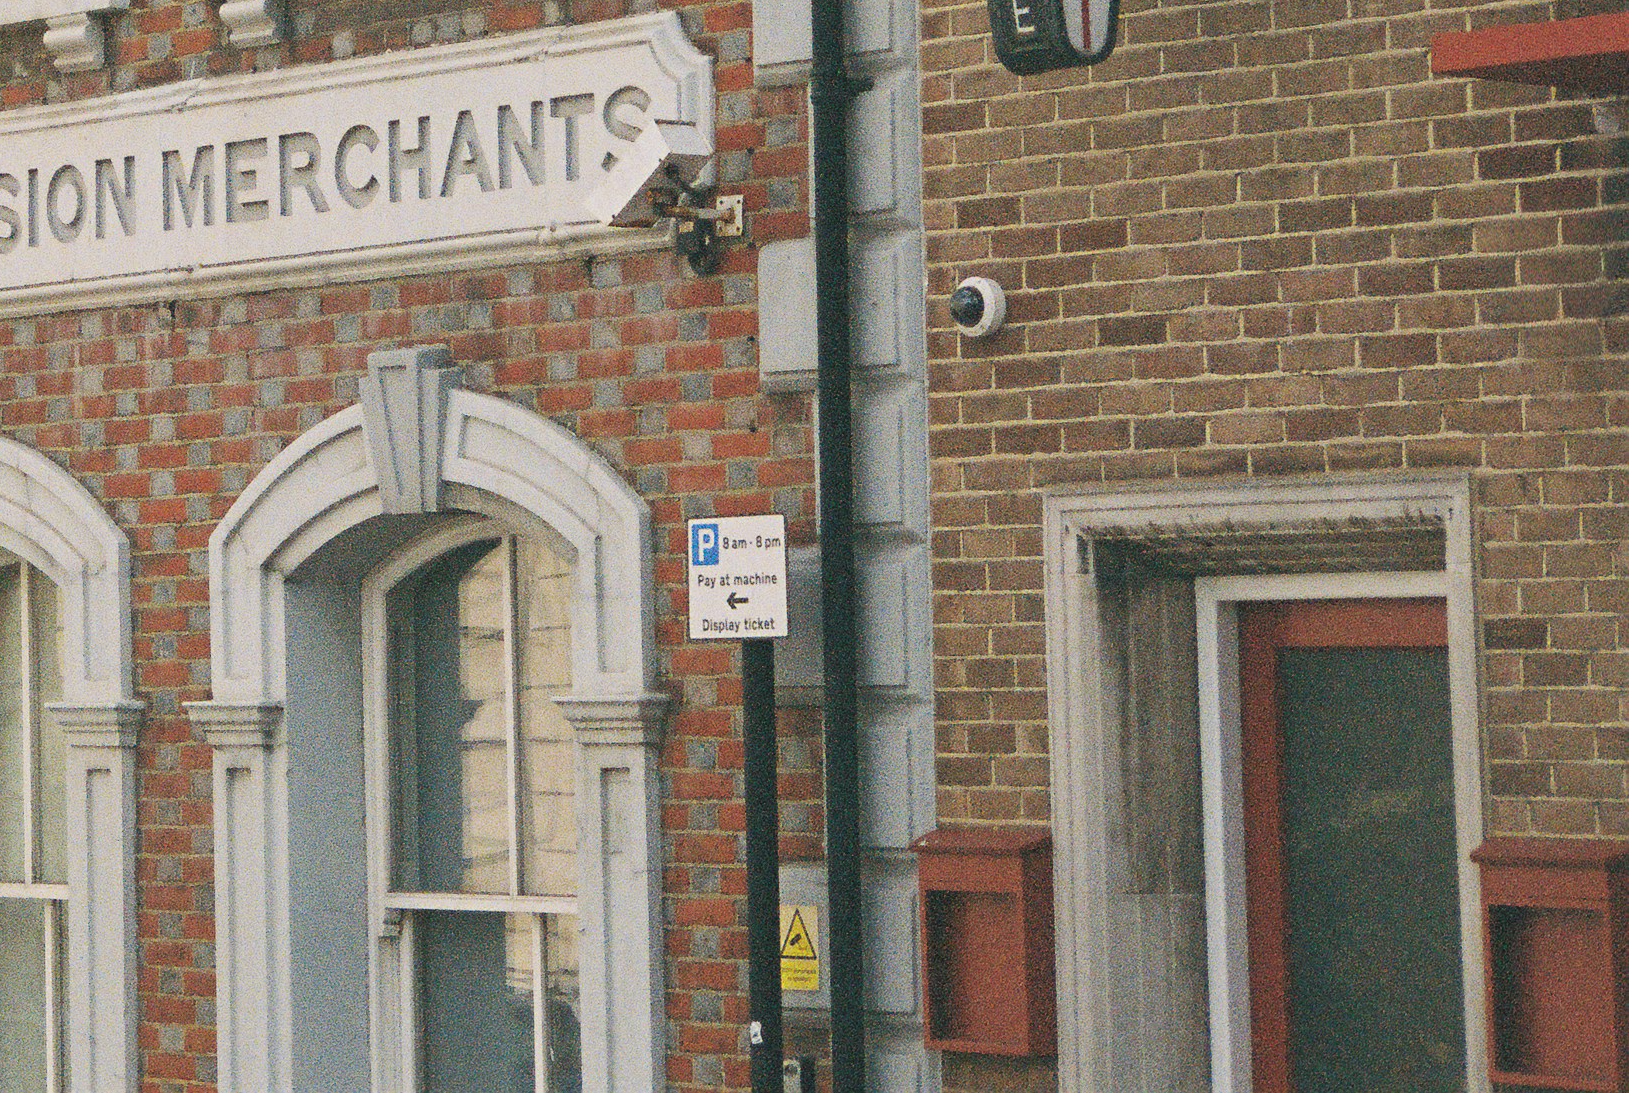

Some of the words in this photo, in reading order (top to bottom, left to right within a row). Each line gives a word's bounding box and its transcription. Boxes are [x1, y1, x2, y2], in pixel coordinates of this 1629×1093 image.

[161, 84, 652, 232] MERCHANTS
[698, 528, 715, 563] P
[697, 574, 716, 589] Pay
[719, 574, 731, 586] at
[733, 572, 778, 586] machine
[702, 618, 741, 633] Display
[744, 617, 775, 630] ticket
